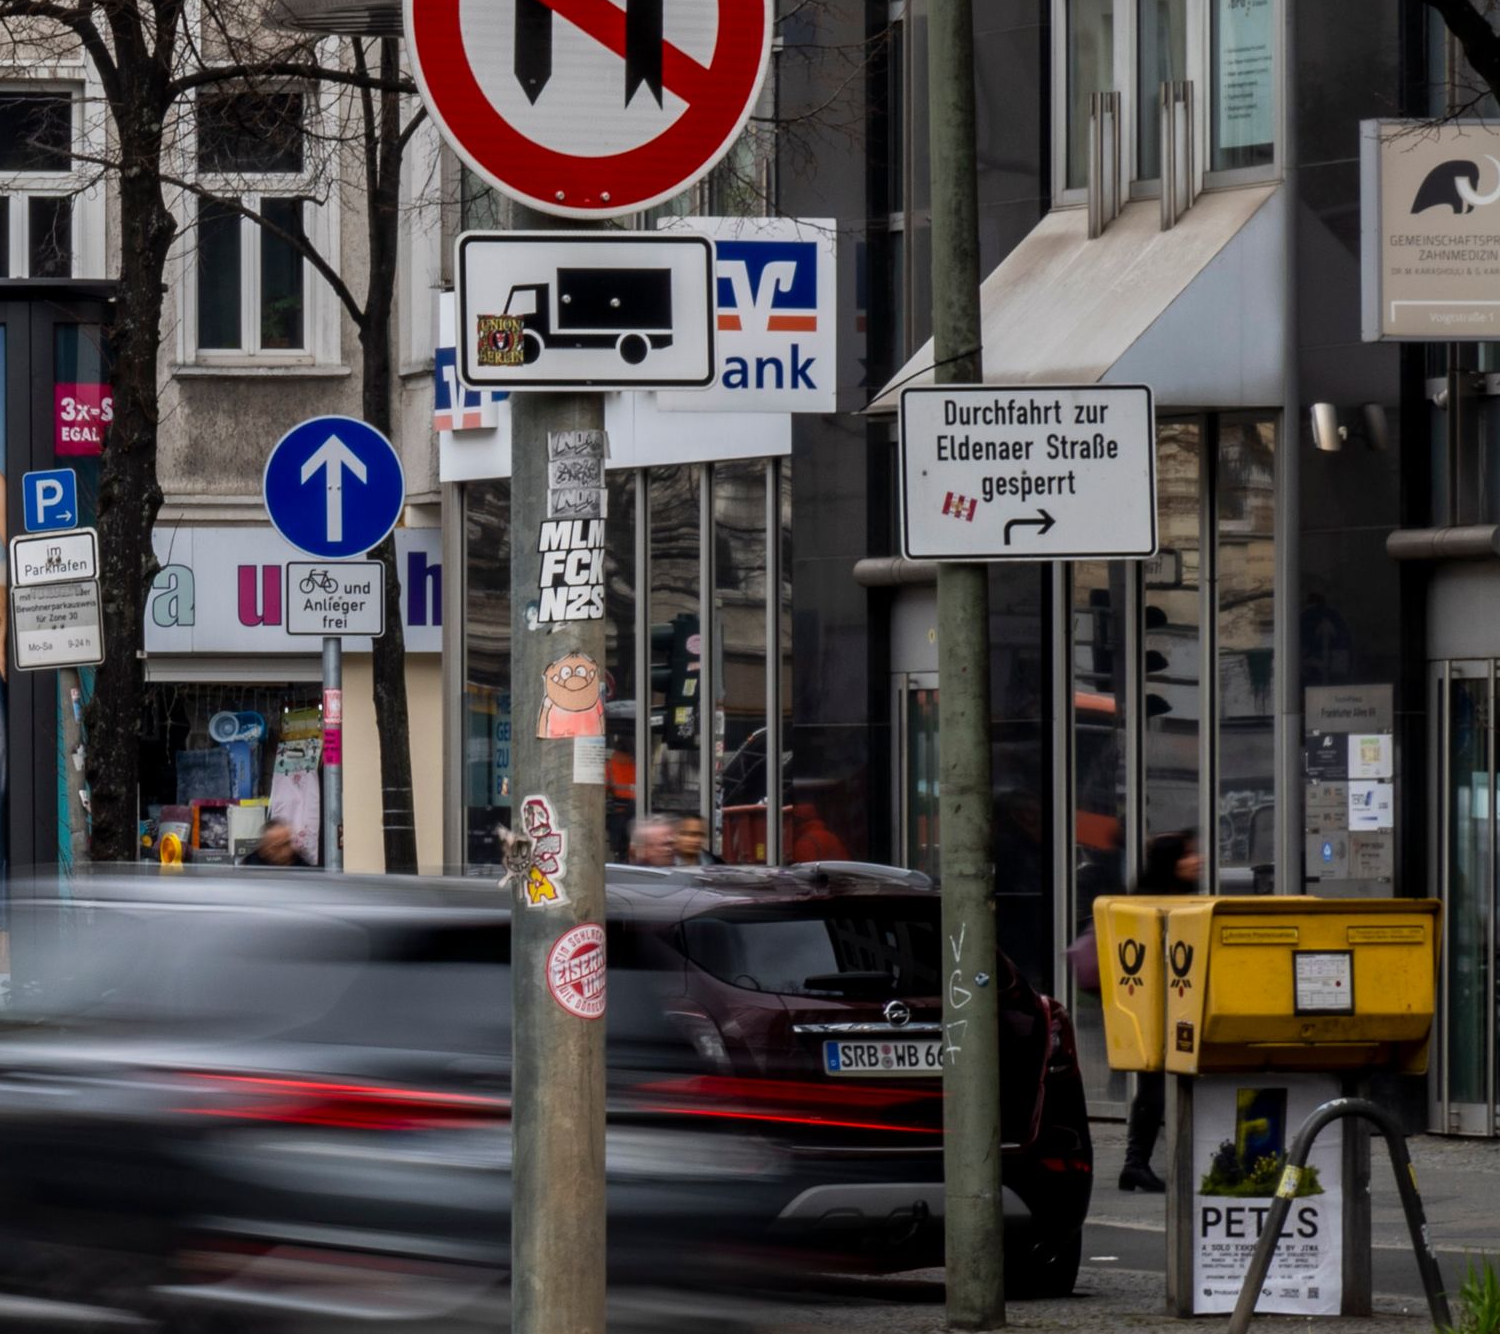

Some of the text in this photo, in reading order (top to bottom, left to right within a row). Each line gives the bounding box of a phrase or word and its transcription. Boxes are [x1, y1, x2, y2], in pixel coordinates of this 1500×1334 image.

[1419, 250, 1498, 261] ZAHNMEDIZIN
[481, 318, 520, 332] UNION
[479, 351, 524, 364] BERLIN
[721, 343, 817, 390] ank
[944, 398, 1109, 426] Durchfahrt zur
[61, 427, 101, 442] EGAL
[937, 432, 1119, 461] Eldenaer Straße
[982, 470, 1076, 502] gesperrt
[35, 478, 64, 525] P
[46, 544, 61, 558] im
[24, 558, 87, 577] Parkhafen
[539, 549, 605, 588] FCK
[344, 580, 370, 595] und
[16, 599, 96, 614] Bewohnerparkausweis
[303, 597, 366, 614] Anlieger
[36, 612, 78, 623] für Zone 30
[322, 613, 348, 629] frei
[841, 1044, 880, 1068] SRB
[894, 1043, 920, 1067] WB
